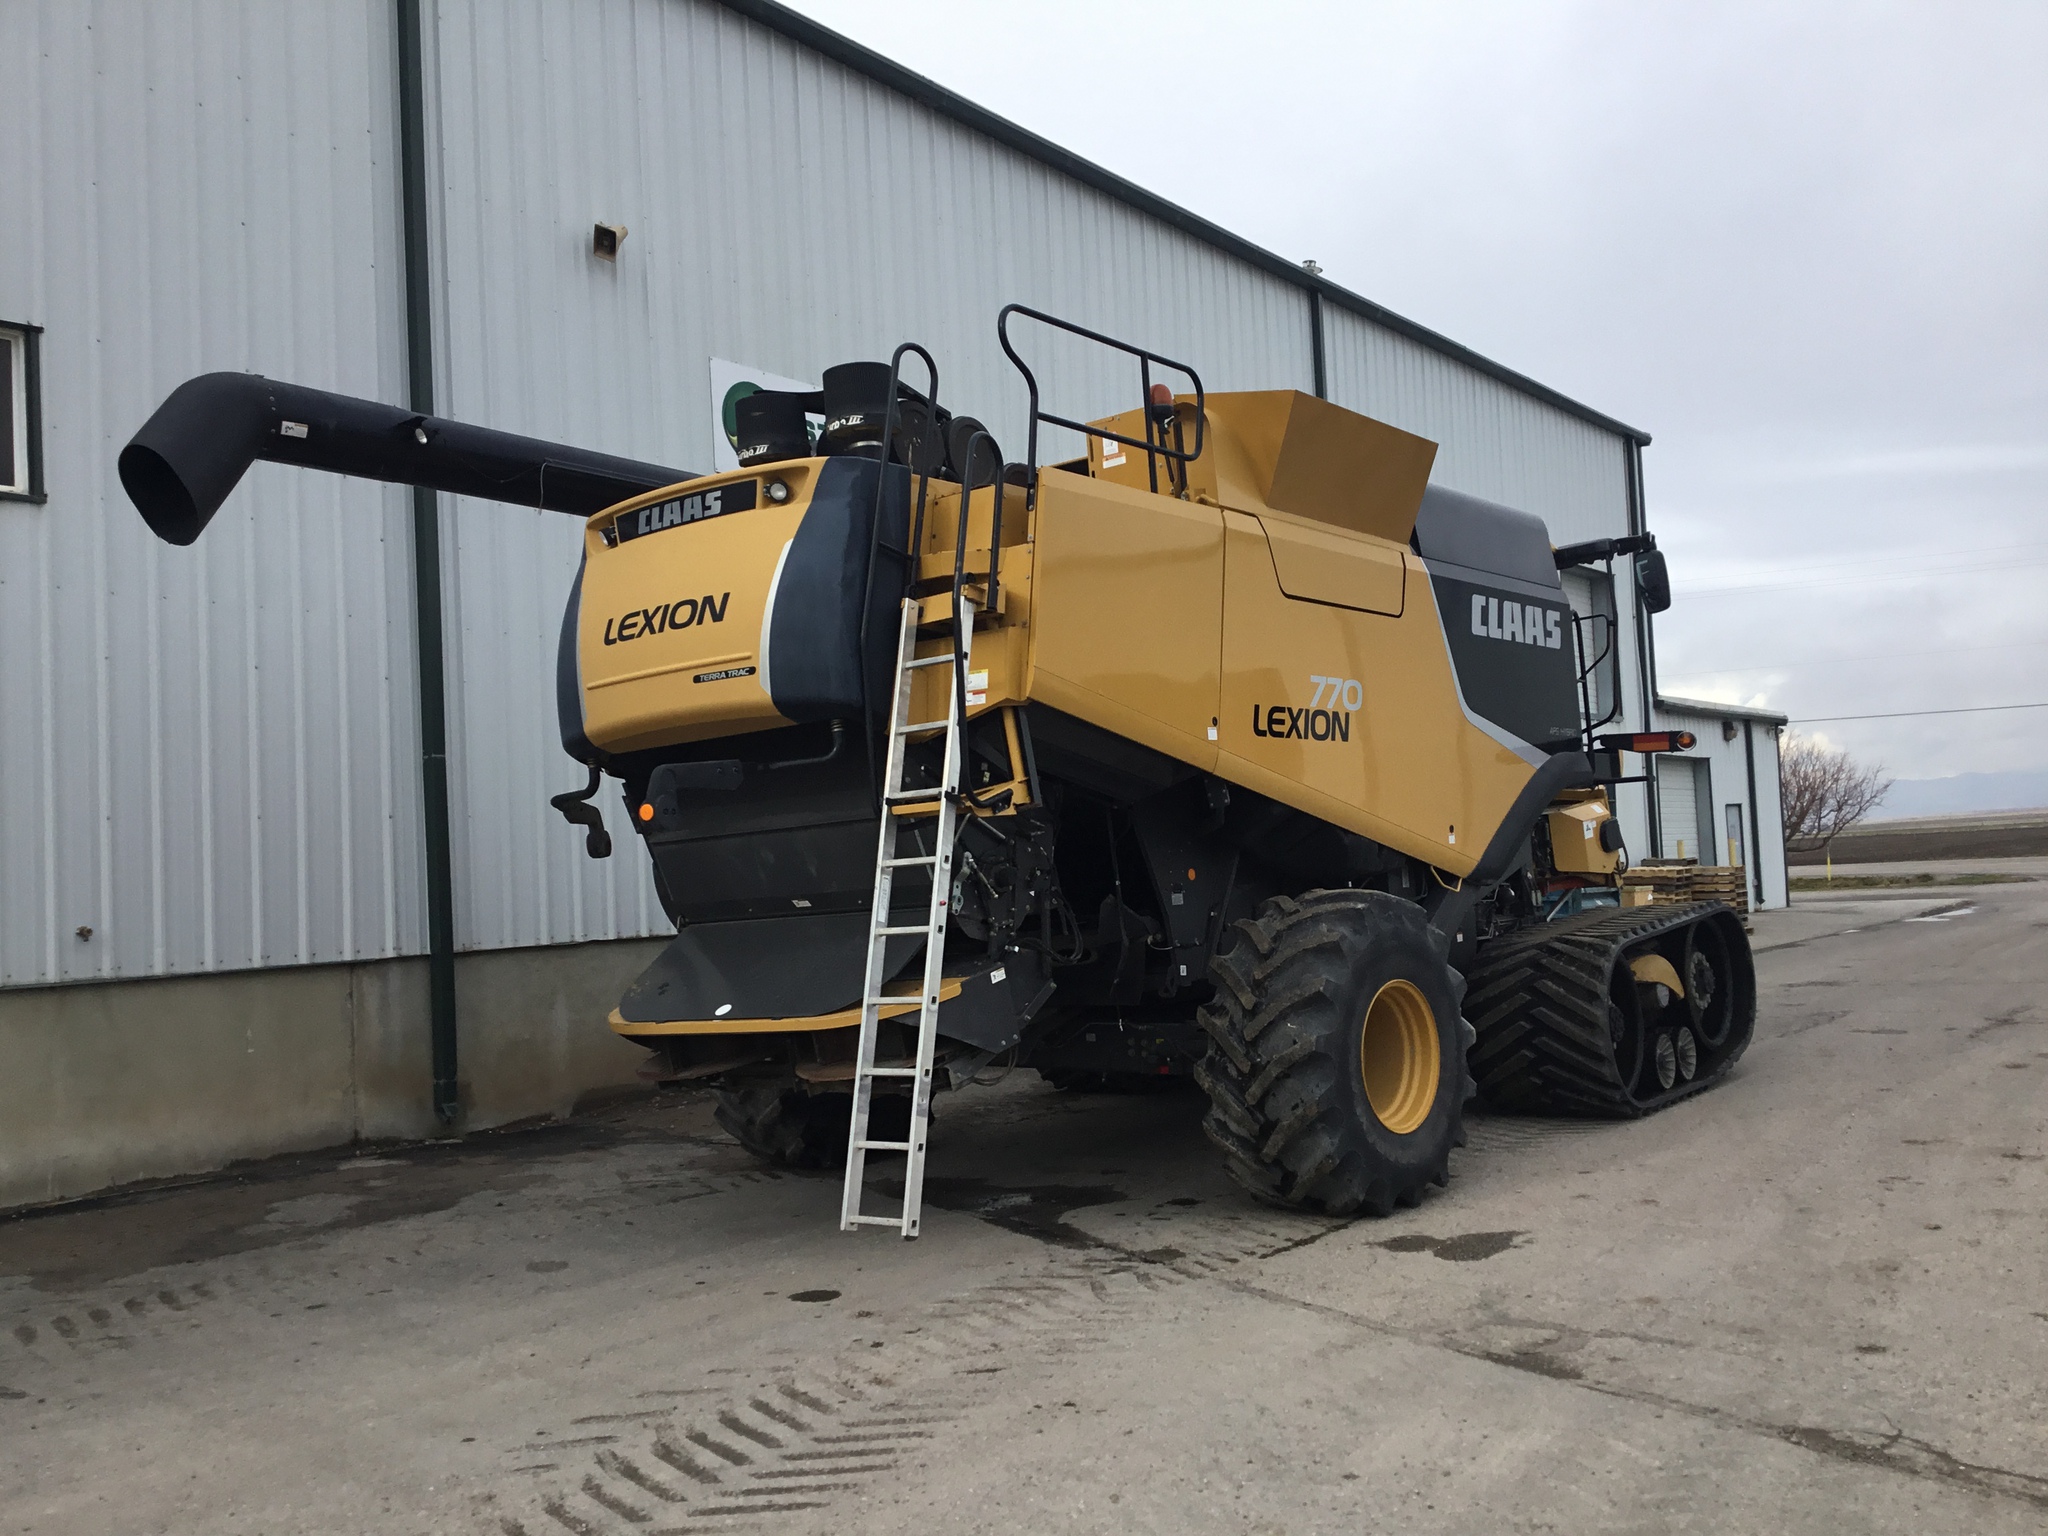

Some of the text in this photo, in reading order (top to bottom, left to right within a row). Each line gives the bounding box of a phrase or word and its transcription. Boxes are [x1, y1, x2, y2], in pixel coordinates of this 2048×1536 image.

[638, 489, 722, 535] CLAAS
[603, 592, 731, 646] LEXION
[1471, 593, 1562, 650] CLAAS
[699, 667, 750, 682] TERRA TRAC
[1309, 674, 1363, 712] 770
[1252, 703, 1350, 743] LEXION
